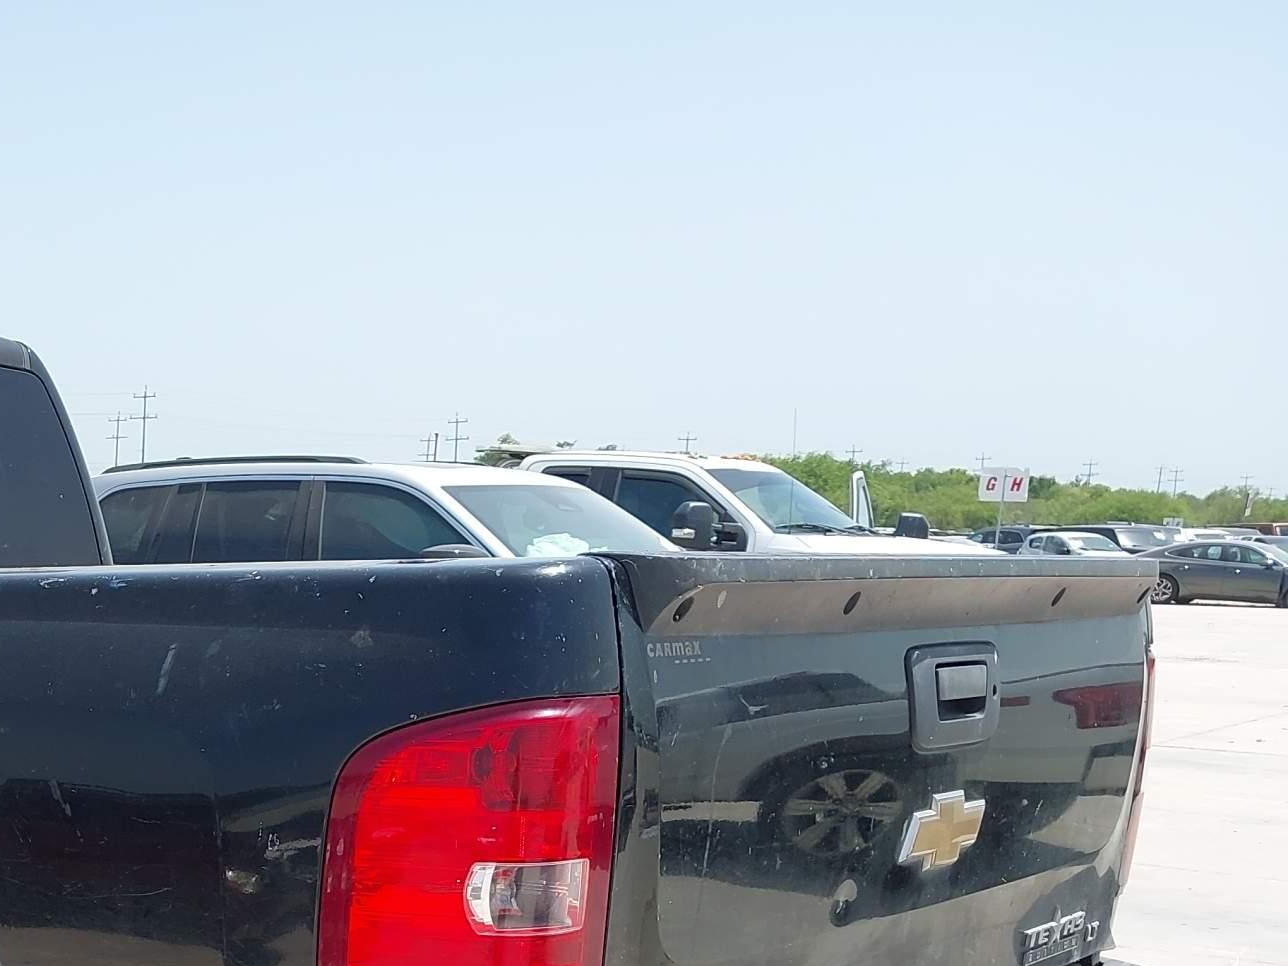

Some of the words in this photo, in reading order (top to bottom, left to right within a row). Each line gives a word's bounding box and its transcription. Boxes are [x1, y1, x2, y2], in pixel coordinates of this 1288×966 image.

[986, 477, 998, 491] G
[1010, 477, 1024, 491] H
[1023, 908, 1086, 948] TEXAS
